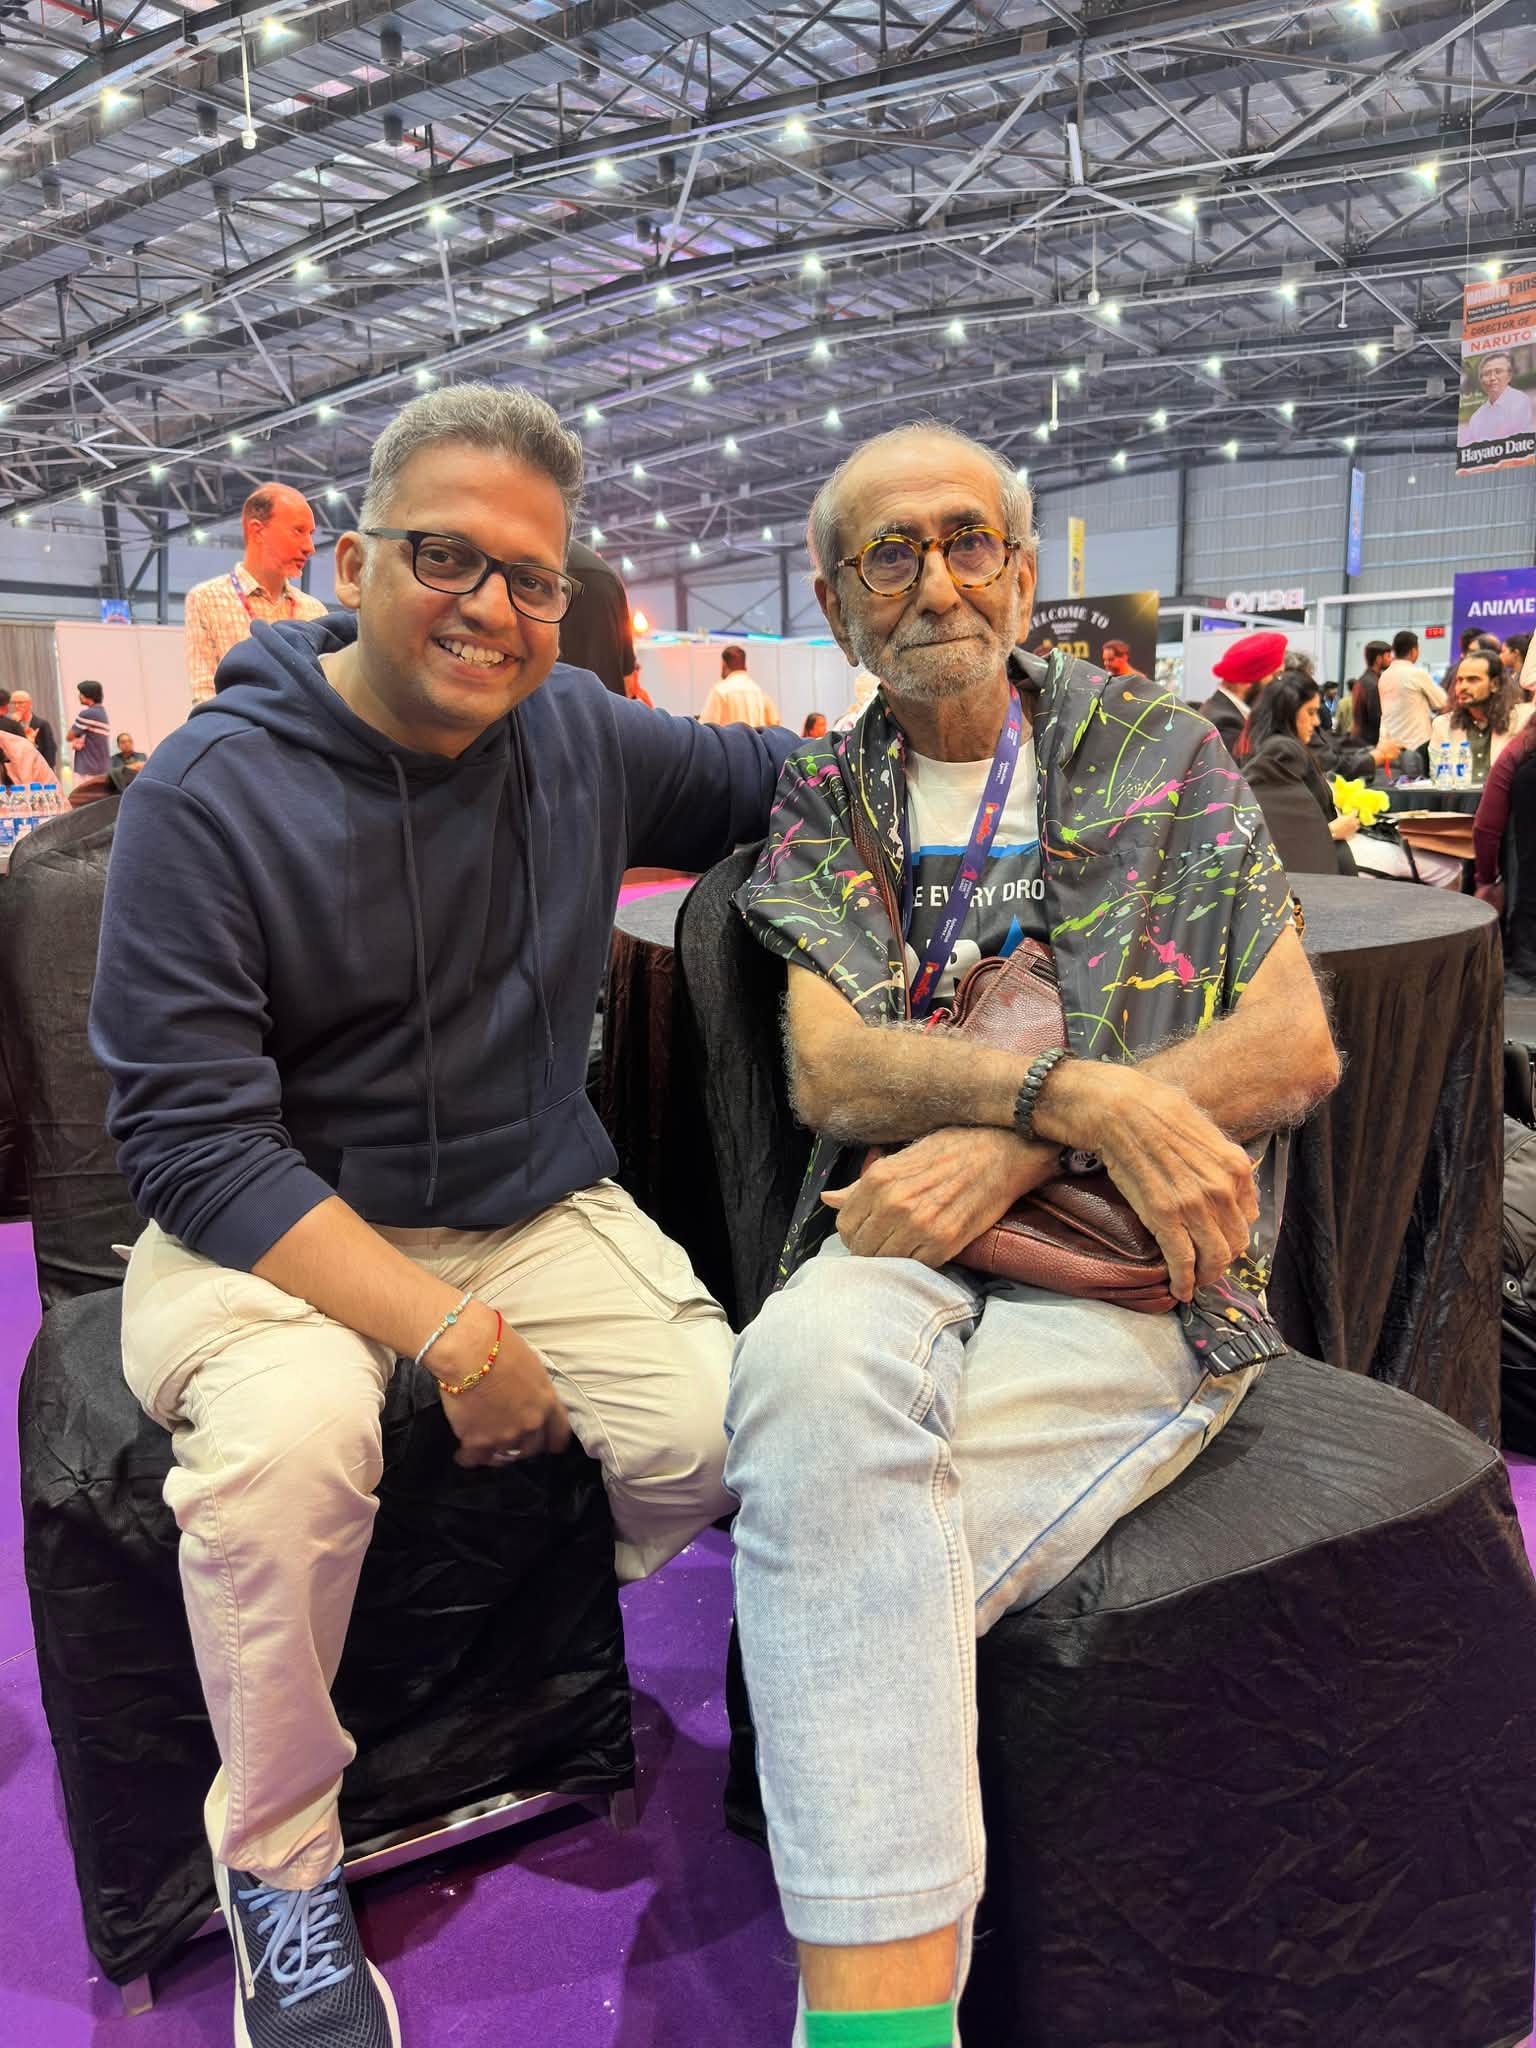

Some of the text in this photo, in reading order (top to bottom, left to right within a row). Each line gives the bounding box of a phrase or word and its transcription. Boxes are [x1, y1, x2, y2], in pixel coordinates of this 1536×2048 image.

[1470, 330, 1531, 352] NARUTO
[1461, 440, 1535, 464] Hayato Date
[1029, 605, 1088, 631] ELCOME
[1090, 610, 1110, 629] TO
[1467, 598, 1536, 617] ANIME
[930, 885, 997, 908] EVRY
